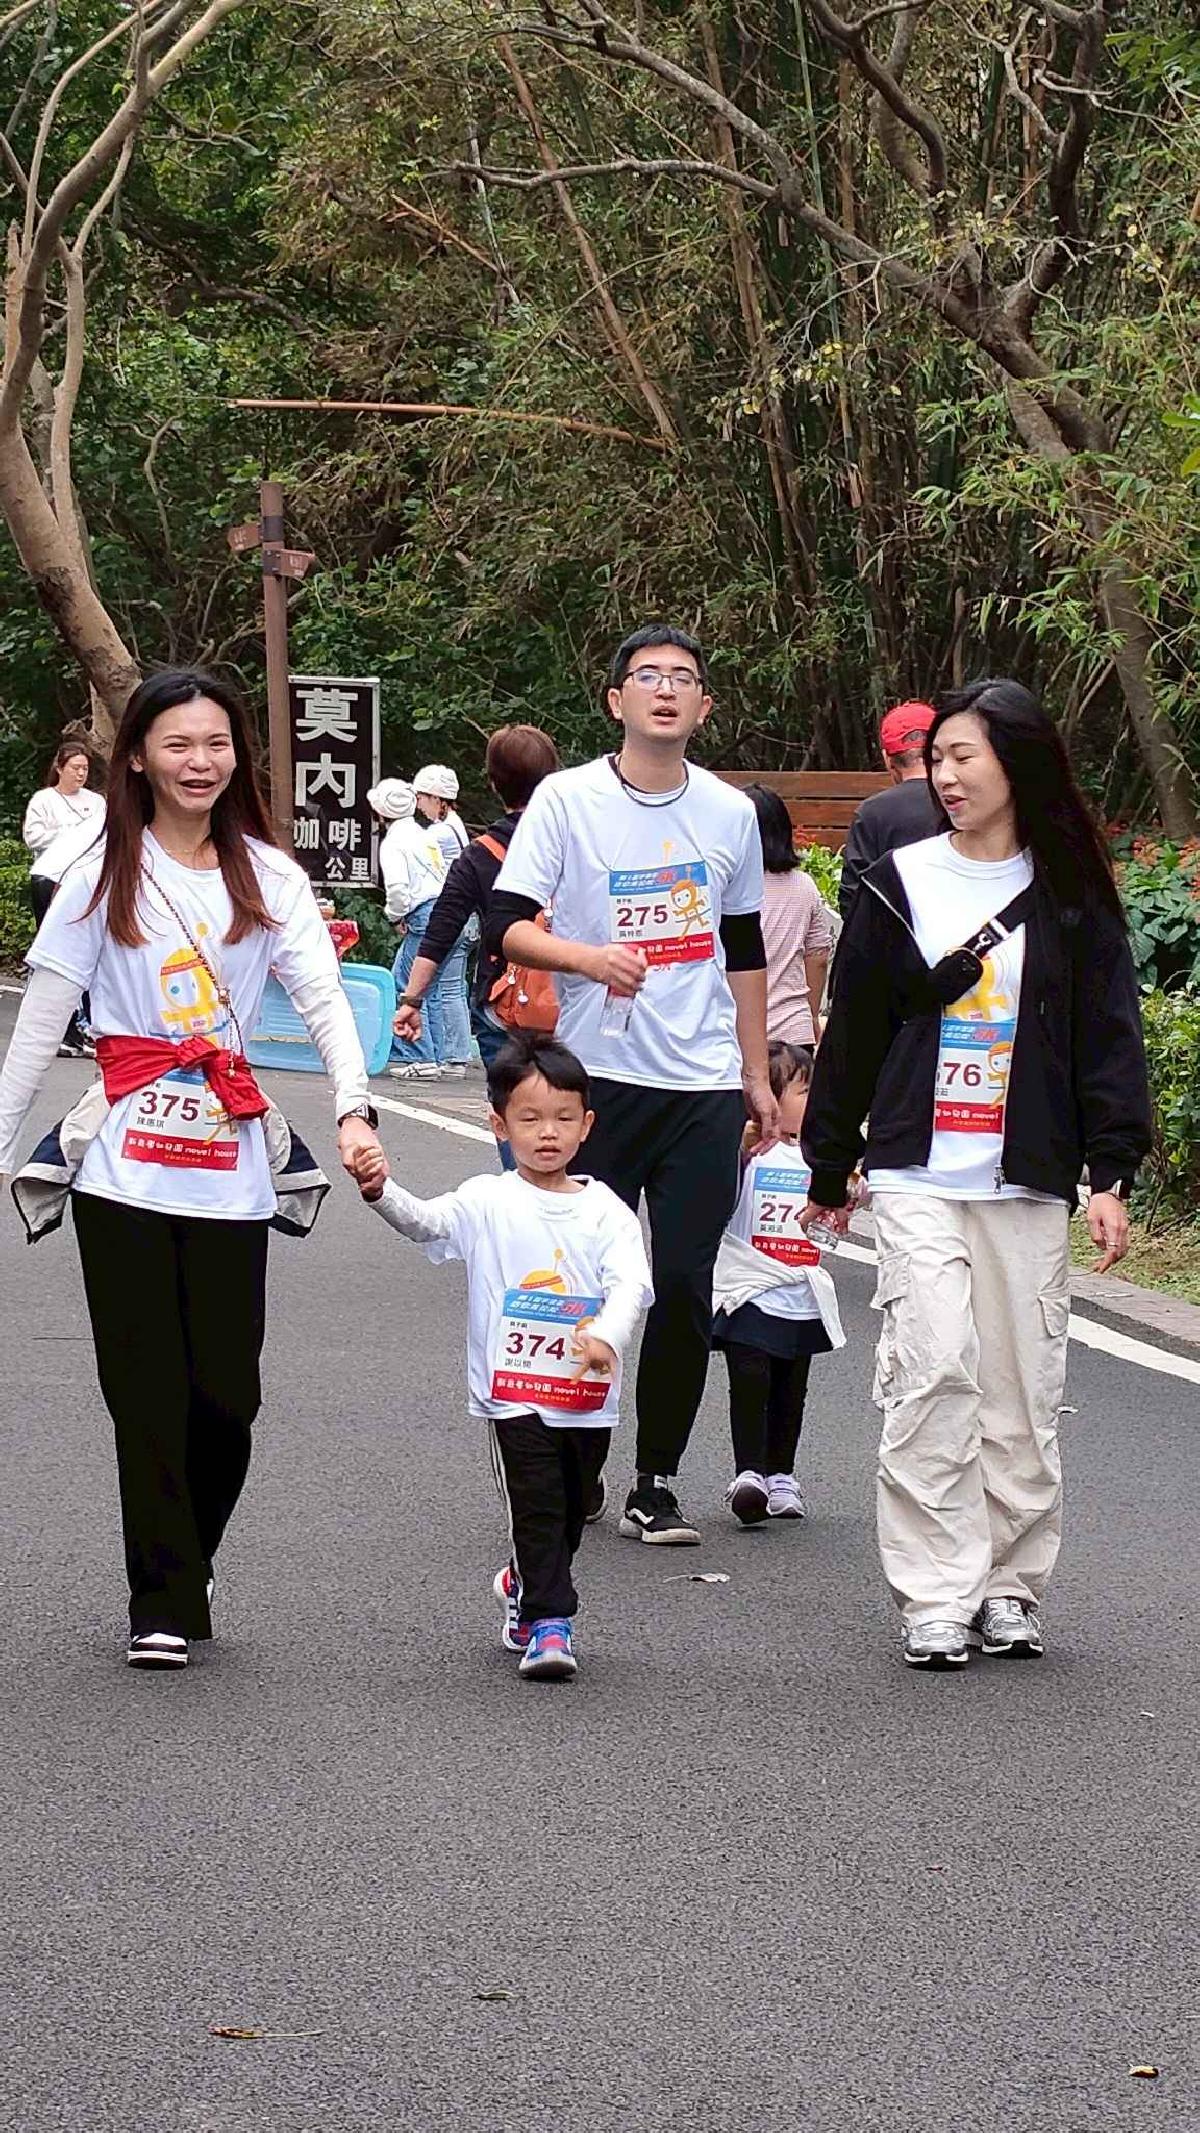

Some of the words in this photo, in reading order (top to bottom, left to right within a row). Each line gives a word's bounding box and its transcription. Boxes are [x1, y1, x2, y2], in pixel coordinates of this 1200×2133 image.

[295, 687, 359, 809] 莫內
[293, 816, 362, 851] 咖啡
[325, 856, 370, 881] 公里
[616, 904, 668, 927] 275
[936, 1062, 982, 1086] 76
[138, 1091, 201, 1121] 375
[185, 1145, 211, 1157] novel
[506, 1332, 566, 1360] 374
[554, 1385, 580, 1396] novel
